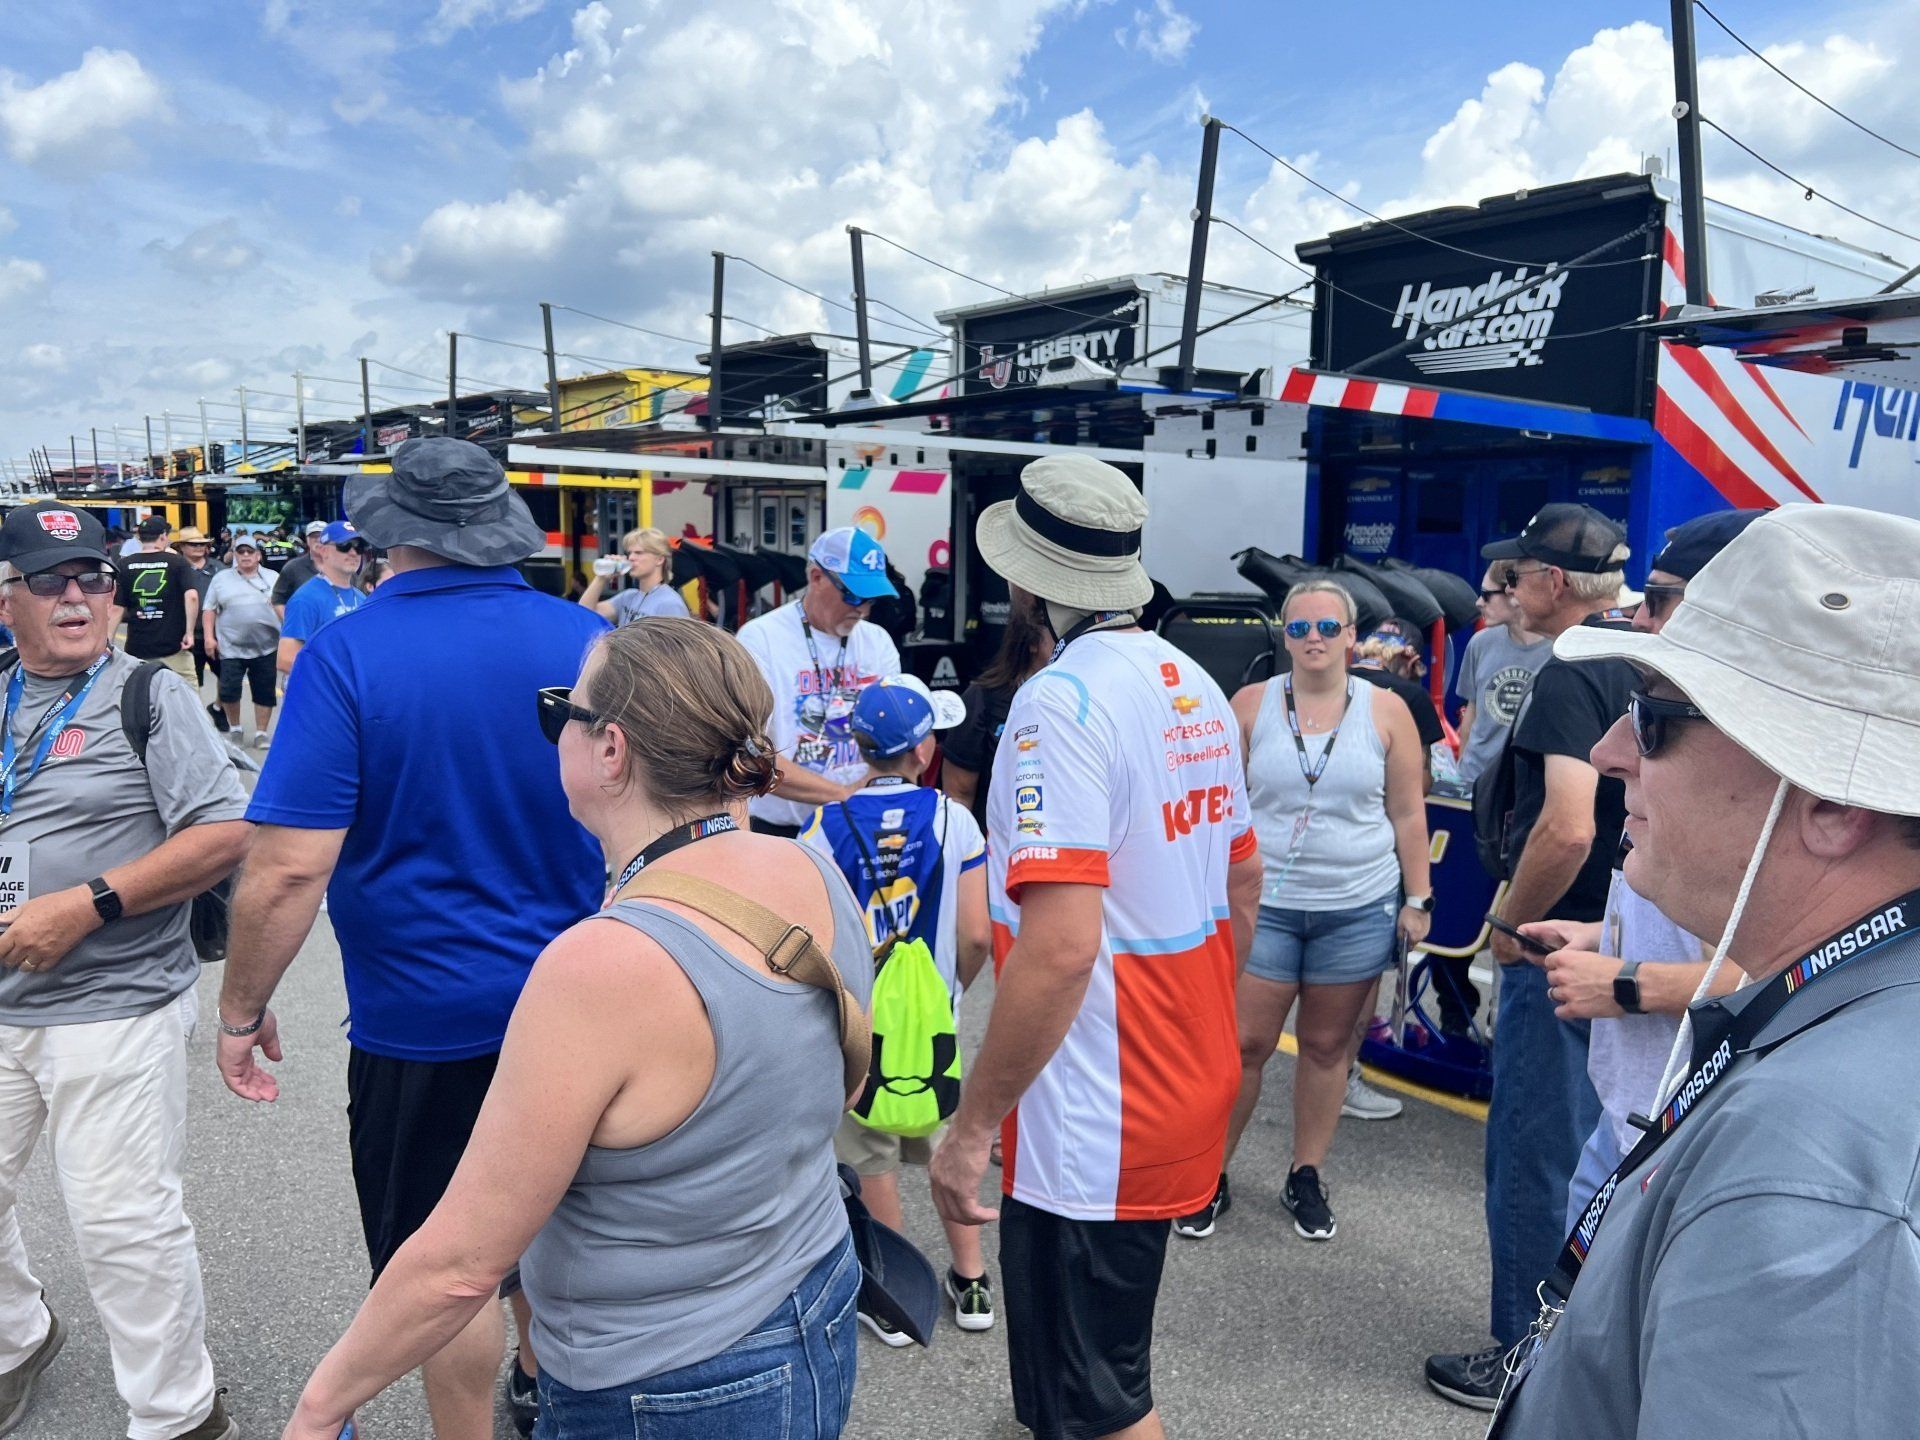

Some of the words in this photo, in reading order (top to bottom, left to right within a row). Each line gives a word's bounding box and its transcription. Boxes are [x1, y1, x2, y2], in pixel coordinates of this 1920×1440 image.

[1391, 262, 1569, 340] Hendrick
[1017, 329, 1120, 367] LIBERTY
[1159, 662, 1181, 688] 9
[1020, 793, 1036, 805] NAPA
[1809, 905, 1907, 975] NASCAR
[1677, 1039, 1732, 1116] NASCAR
[1578, 1173, 1618, 1247] NASCAR
